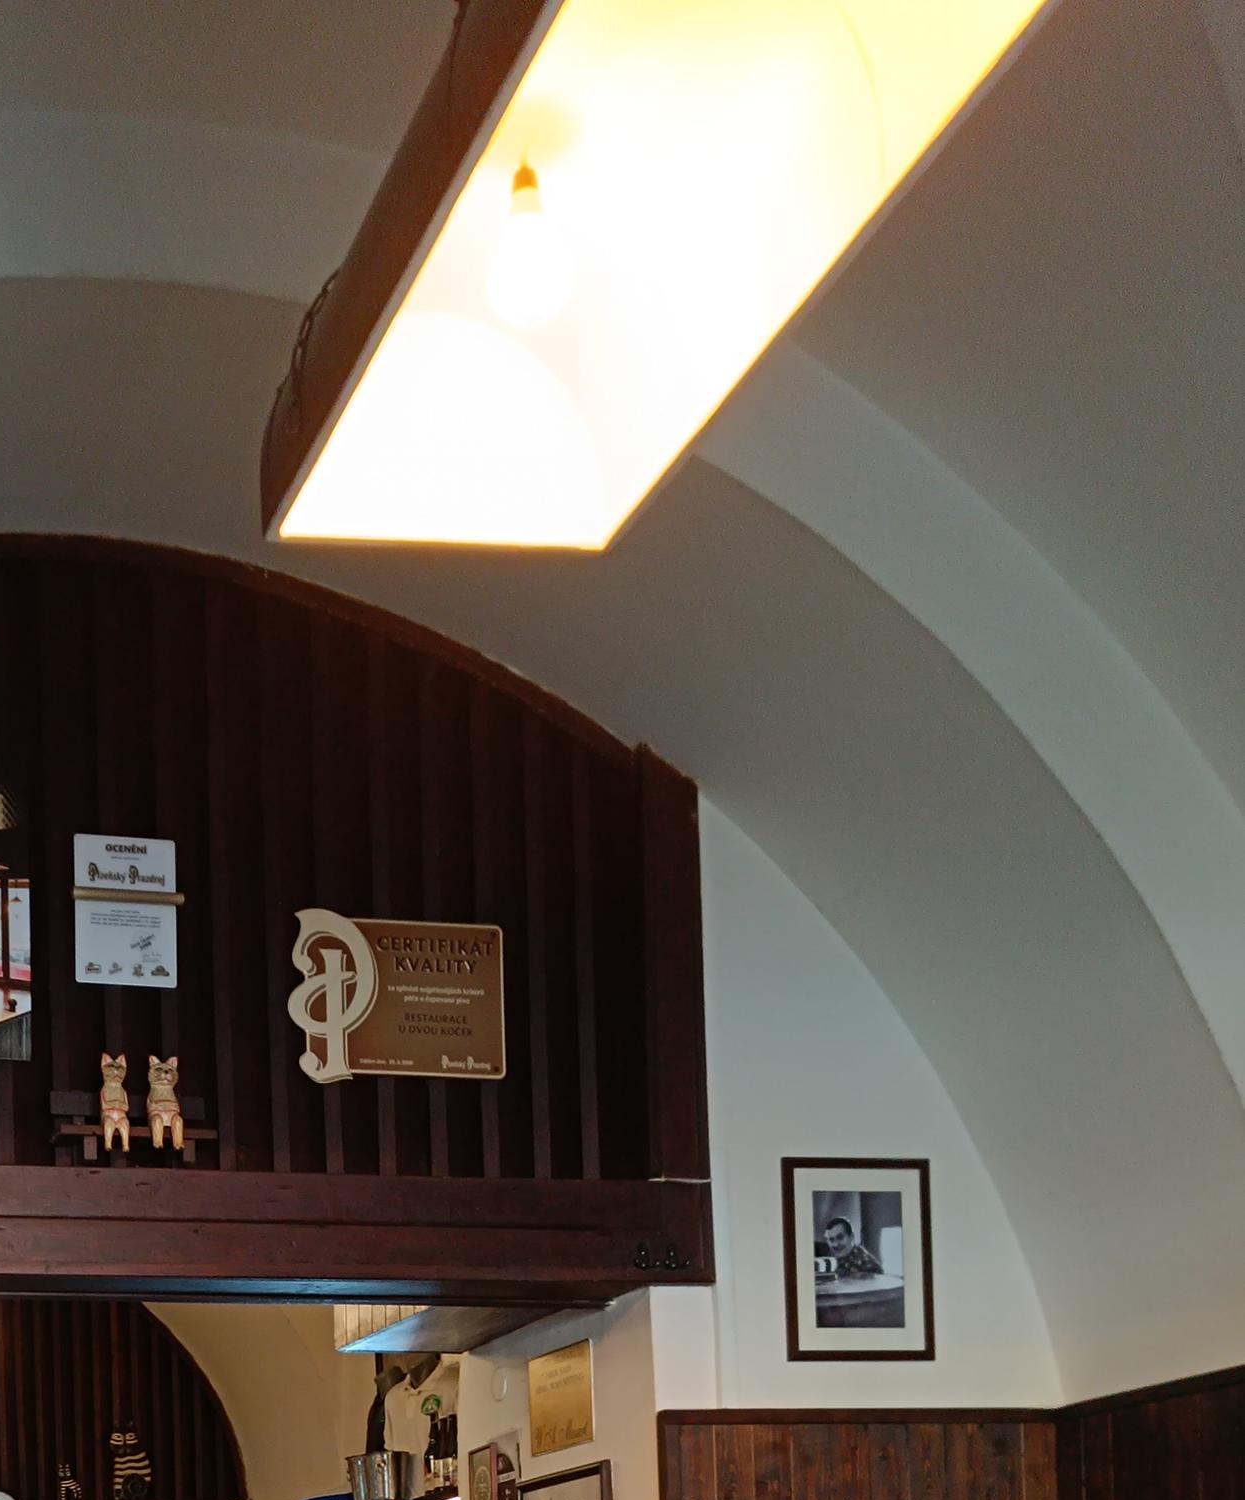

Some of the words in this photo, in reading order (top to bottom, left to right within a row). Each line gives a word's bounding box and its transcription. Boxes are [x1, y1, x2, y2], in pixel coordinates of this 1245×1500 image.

[105, 843, 148, 855] OCENĚNÍ
[394, 957, 477, 975] KVALITY
[404, 1012, 468, 1025] RESTAURACE
[408, 1026, 438, 1036] DVOU
